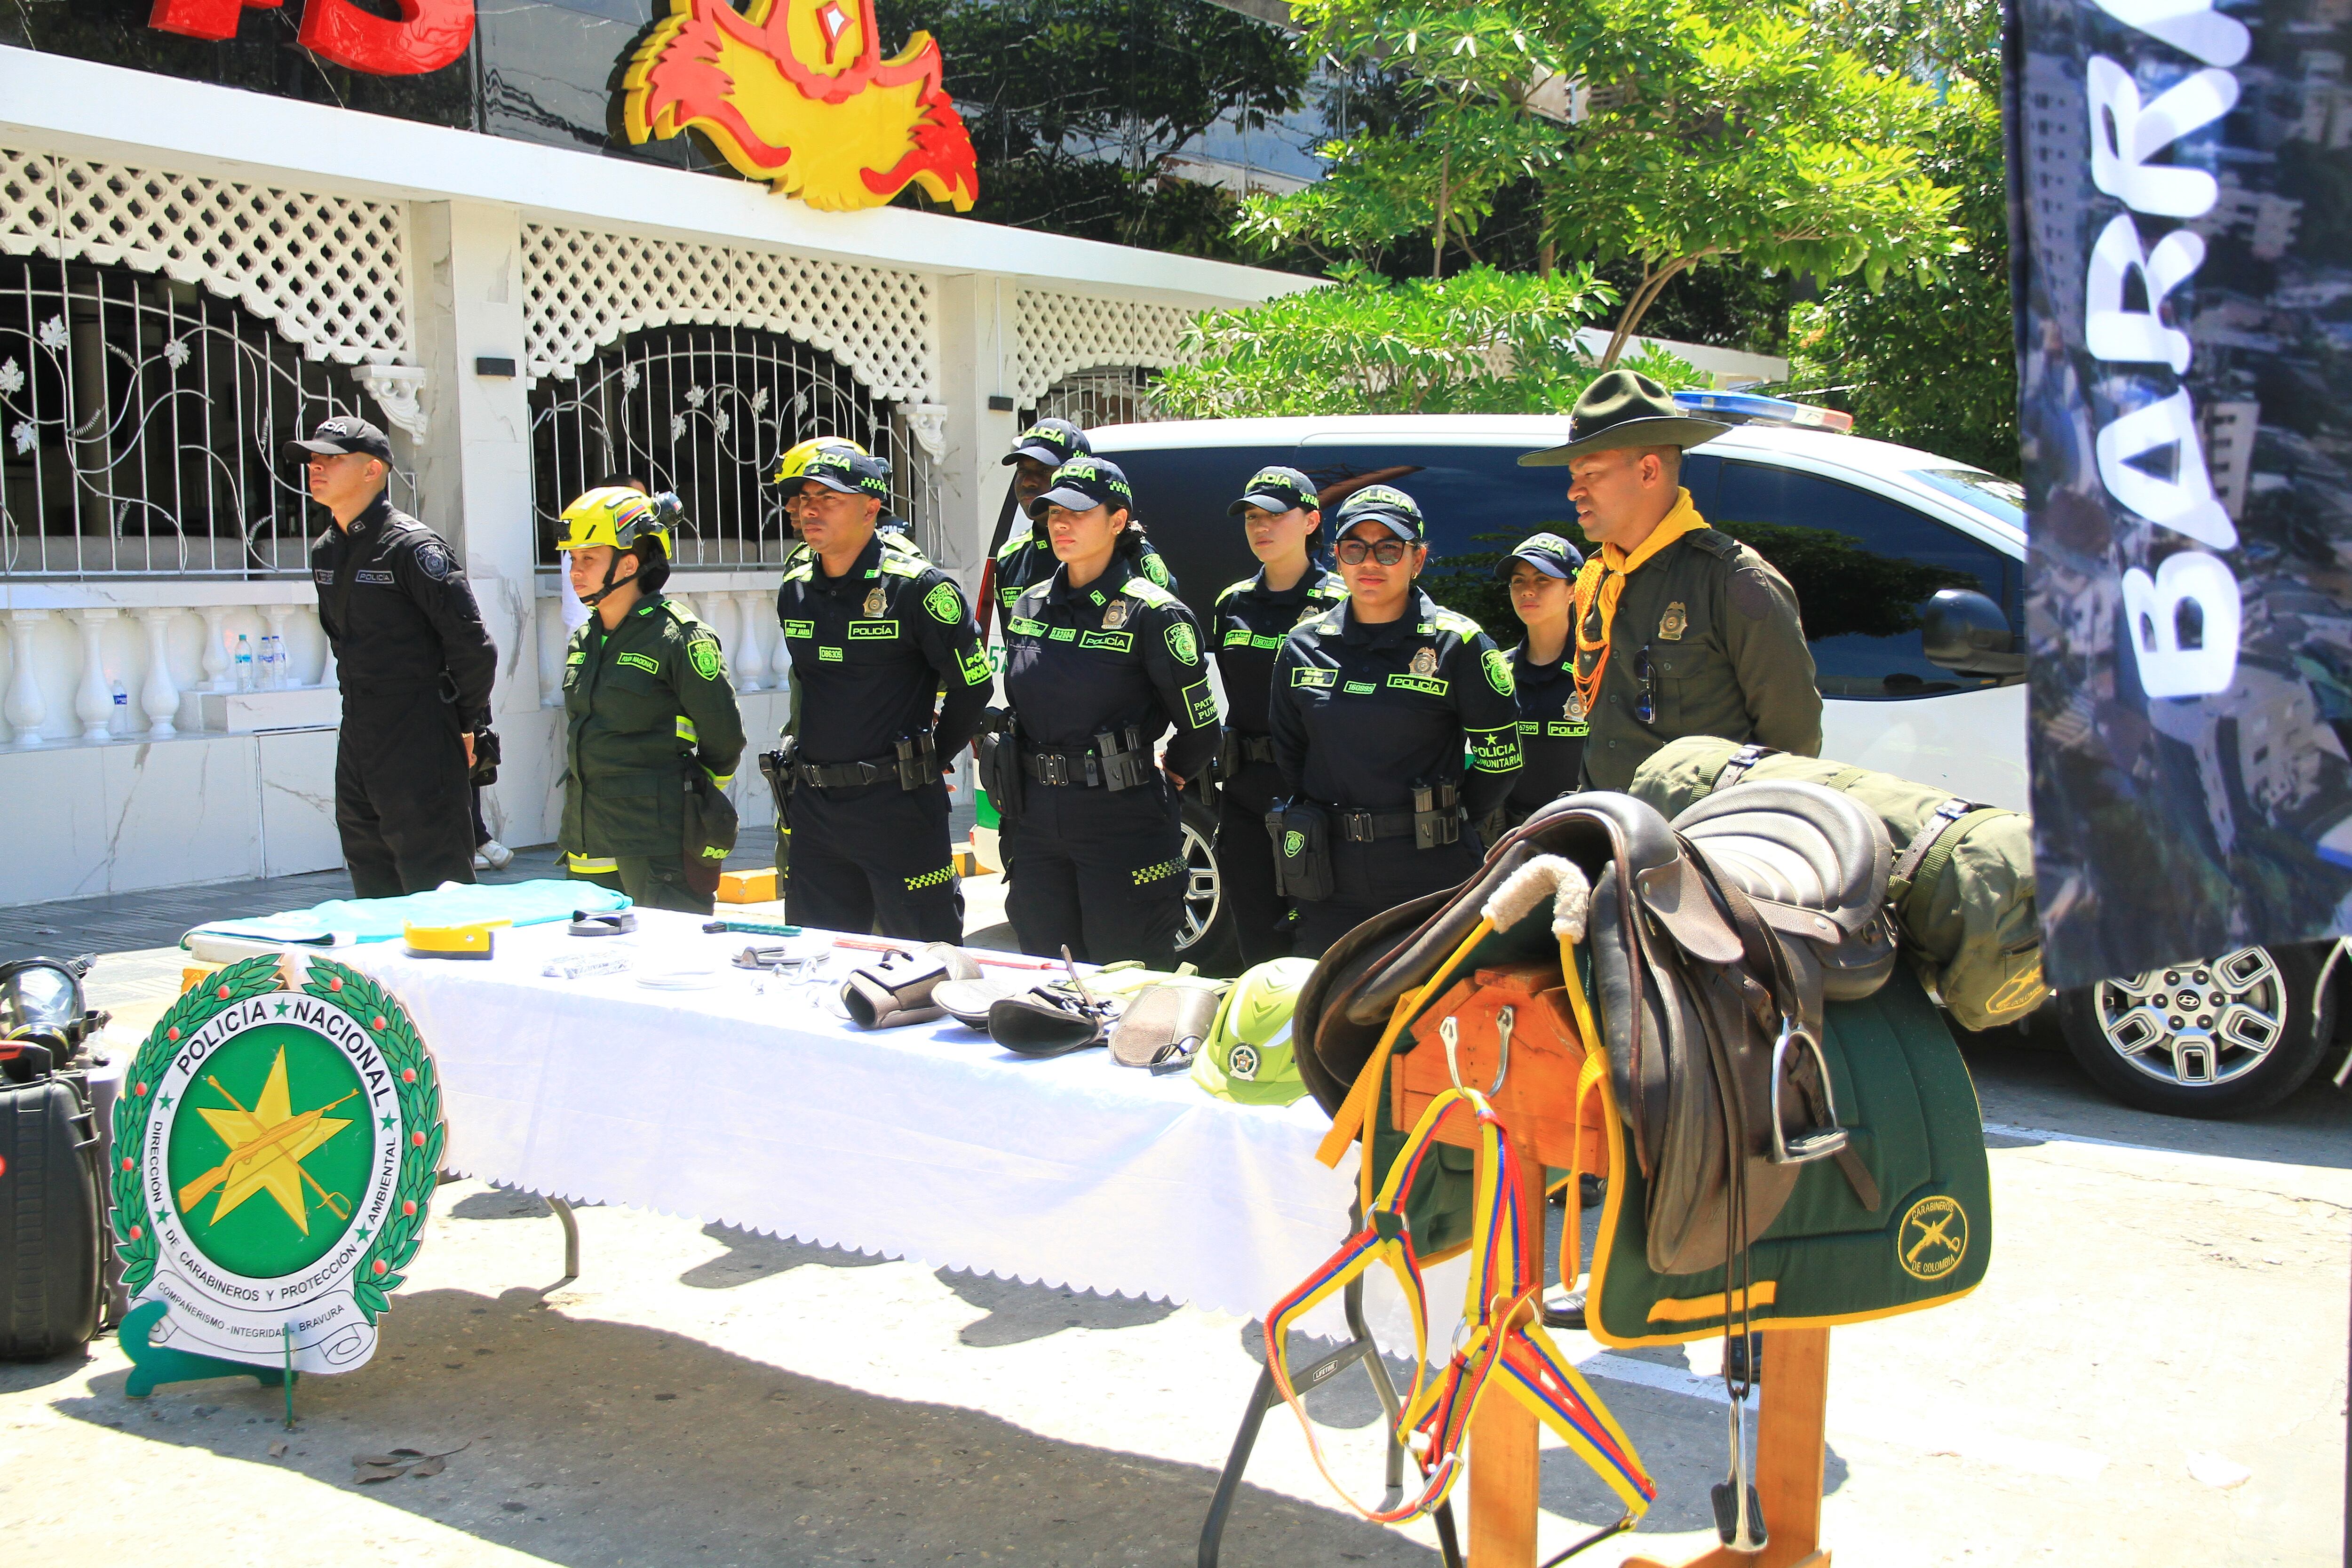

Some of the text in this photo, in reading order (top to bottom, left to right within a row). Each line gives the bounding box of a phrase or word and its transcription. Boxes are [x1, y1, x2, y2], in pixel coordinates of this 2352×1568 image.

[359, 573, 390, 581] POLICÍA
[852, 625, 893, 635] POLICÍA
[1085, 637, 1126, 648] POLICÍA
[632, 656, 654, 670] NACIONAL
[1393, 678, 1440, 692] POLICÍA
[177, 999, 393, 1109] POLICÍA NACIONAL
[150, 1120, 397, 1303] DIRECCIÓN DE CARABINEROS Y PROTECCIÓN AMBIENTAL
[1911, 1201, 1954, 1220] CARABINEROS
[1912, 1254, 1955, 1273] DE COLOMBIA
[157, 1280, 226, 1330] COMPAÑERISMO
[298, 1303, 346, 1333] BRAVURA
[1316, 1362, 1335, 1379] LIFETIME
